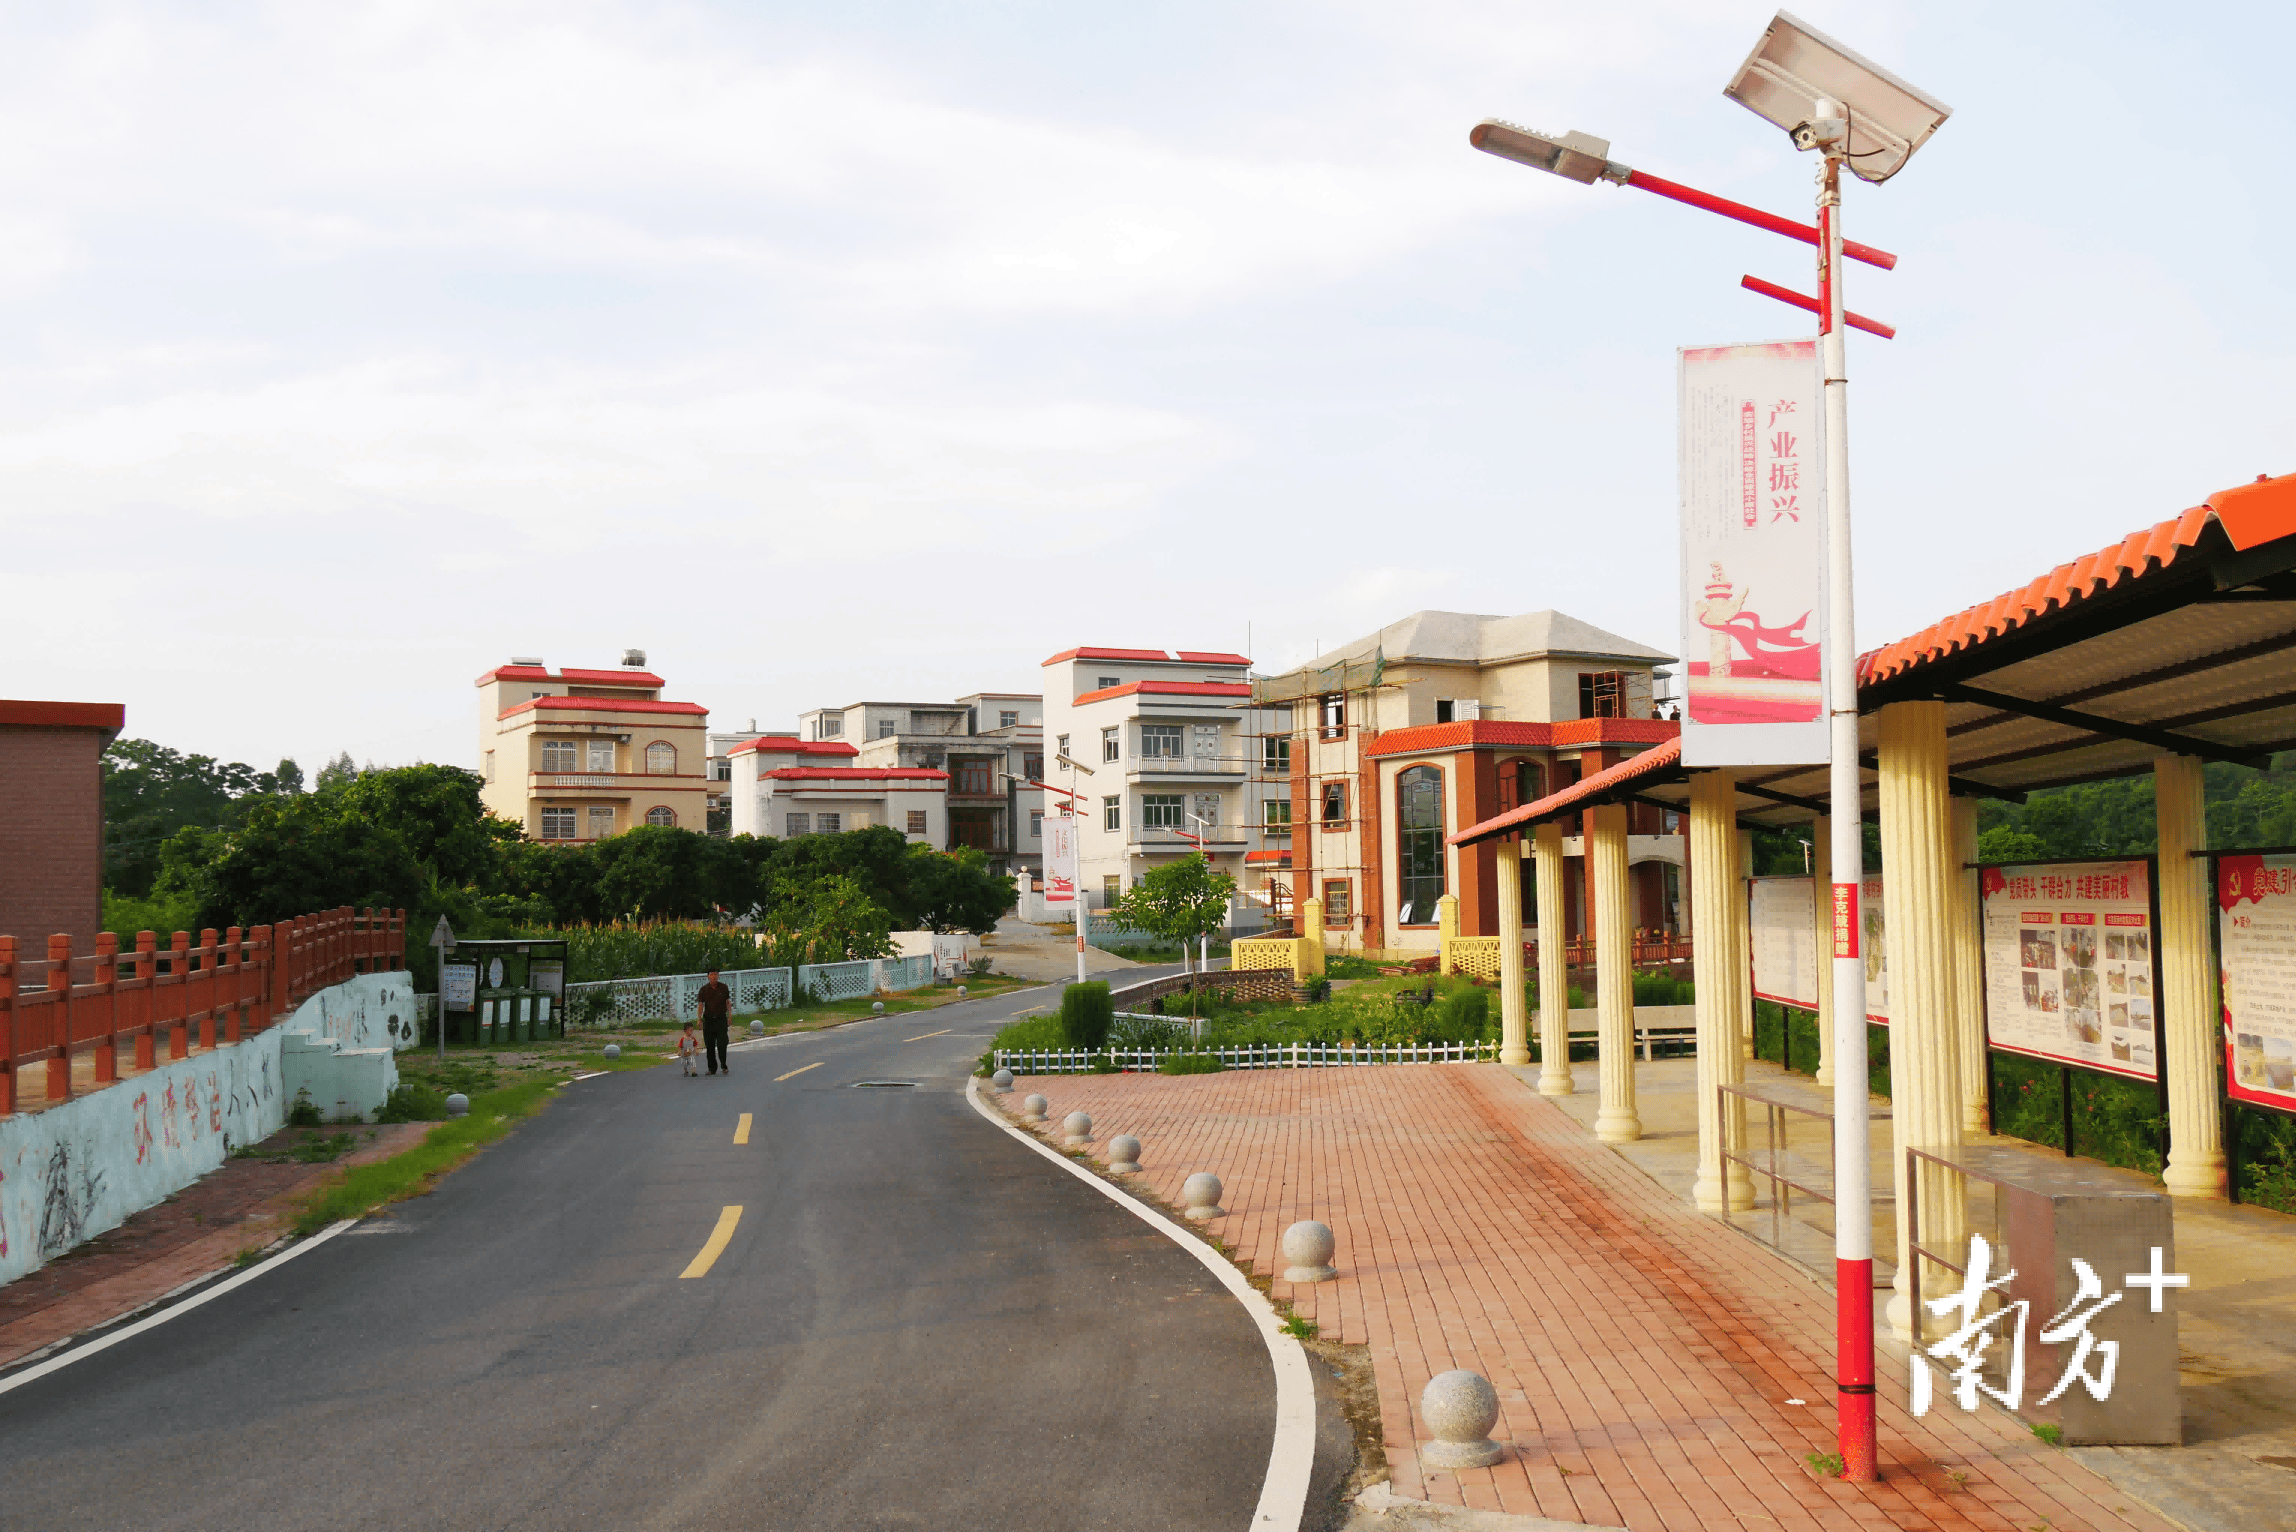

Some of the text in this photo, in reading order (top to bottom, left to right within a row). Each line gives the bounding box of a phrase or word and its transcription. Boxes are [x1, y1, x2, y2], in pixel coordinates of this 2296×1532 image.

[1767, 399, 1799, 524] 产业振兴
[2010, 876, 2037, 900] 党员带头
[2041, 874, 2072, 899] 干群合力
[2253, 866, 2296, 896] 党建引
